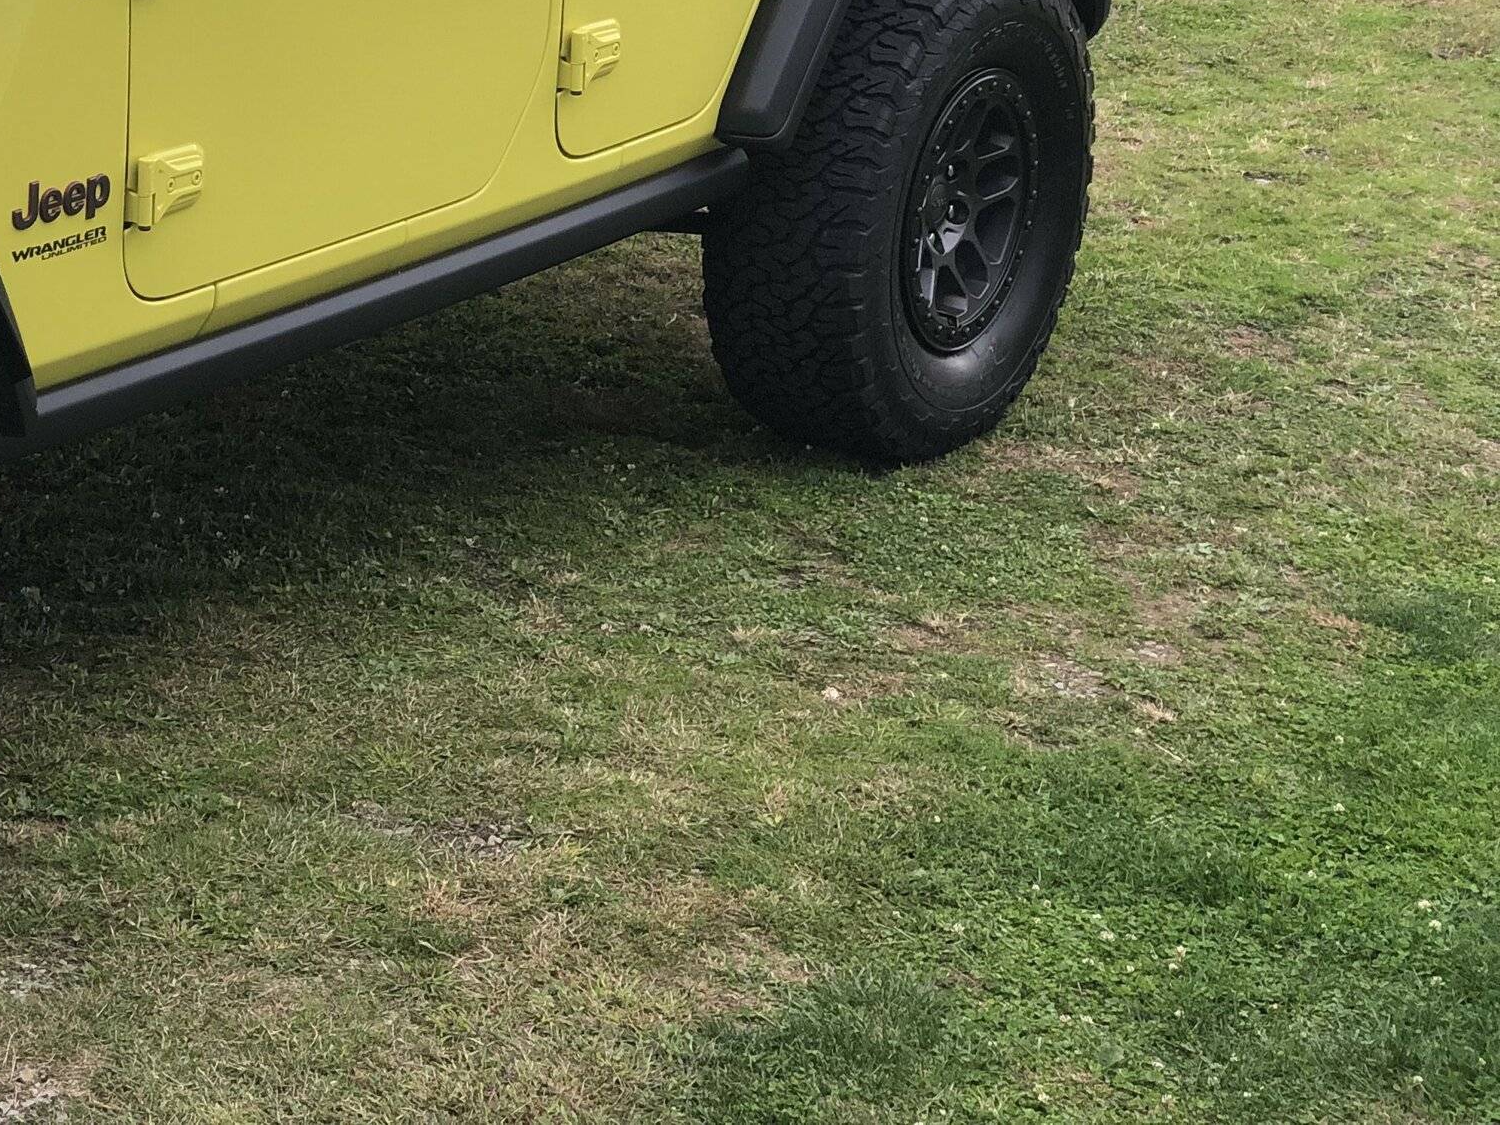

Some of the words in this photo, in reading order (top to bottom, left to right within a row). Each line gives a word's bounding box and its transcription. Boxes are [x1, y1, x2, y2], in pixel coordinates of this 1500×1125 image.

[11, 173, 111, 231] Jeep
[12, 226, 107, 263] WRANGLER
[41, 236, 107, 261] UNLIMITED
